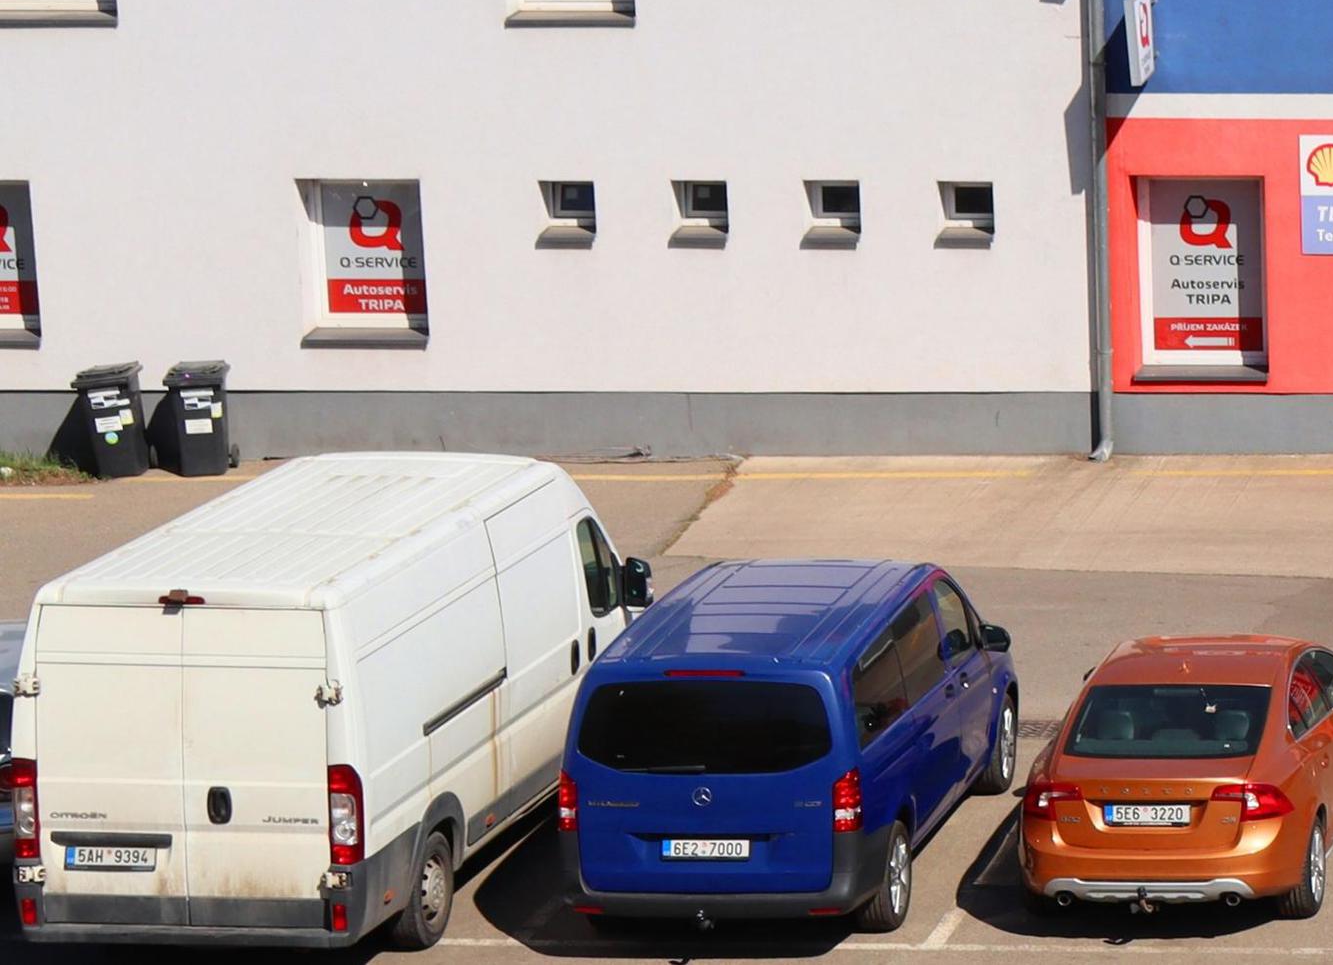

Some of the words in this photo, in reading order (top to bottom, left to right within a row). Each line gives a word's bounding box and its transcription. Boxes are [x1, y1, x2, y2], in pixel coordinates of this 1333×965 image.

[343, 284, 417, 295] Autoservis
[1171, 279, 1245, 290] Autoservis
[358, 299, 405, 310] TRIPA
[1186, 294, 1232, 304] TRIPA
[1116, 807, 1141, 820] 5E6
[1151, 807, 1184, 820] 3220
[674, 842, 698, 856] 6E2
[710, 842, 743, 856] 7000
[78, 849, 104, 863] 5AH
[114, 850, 148, 864] 9394
